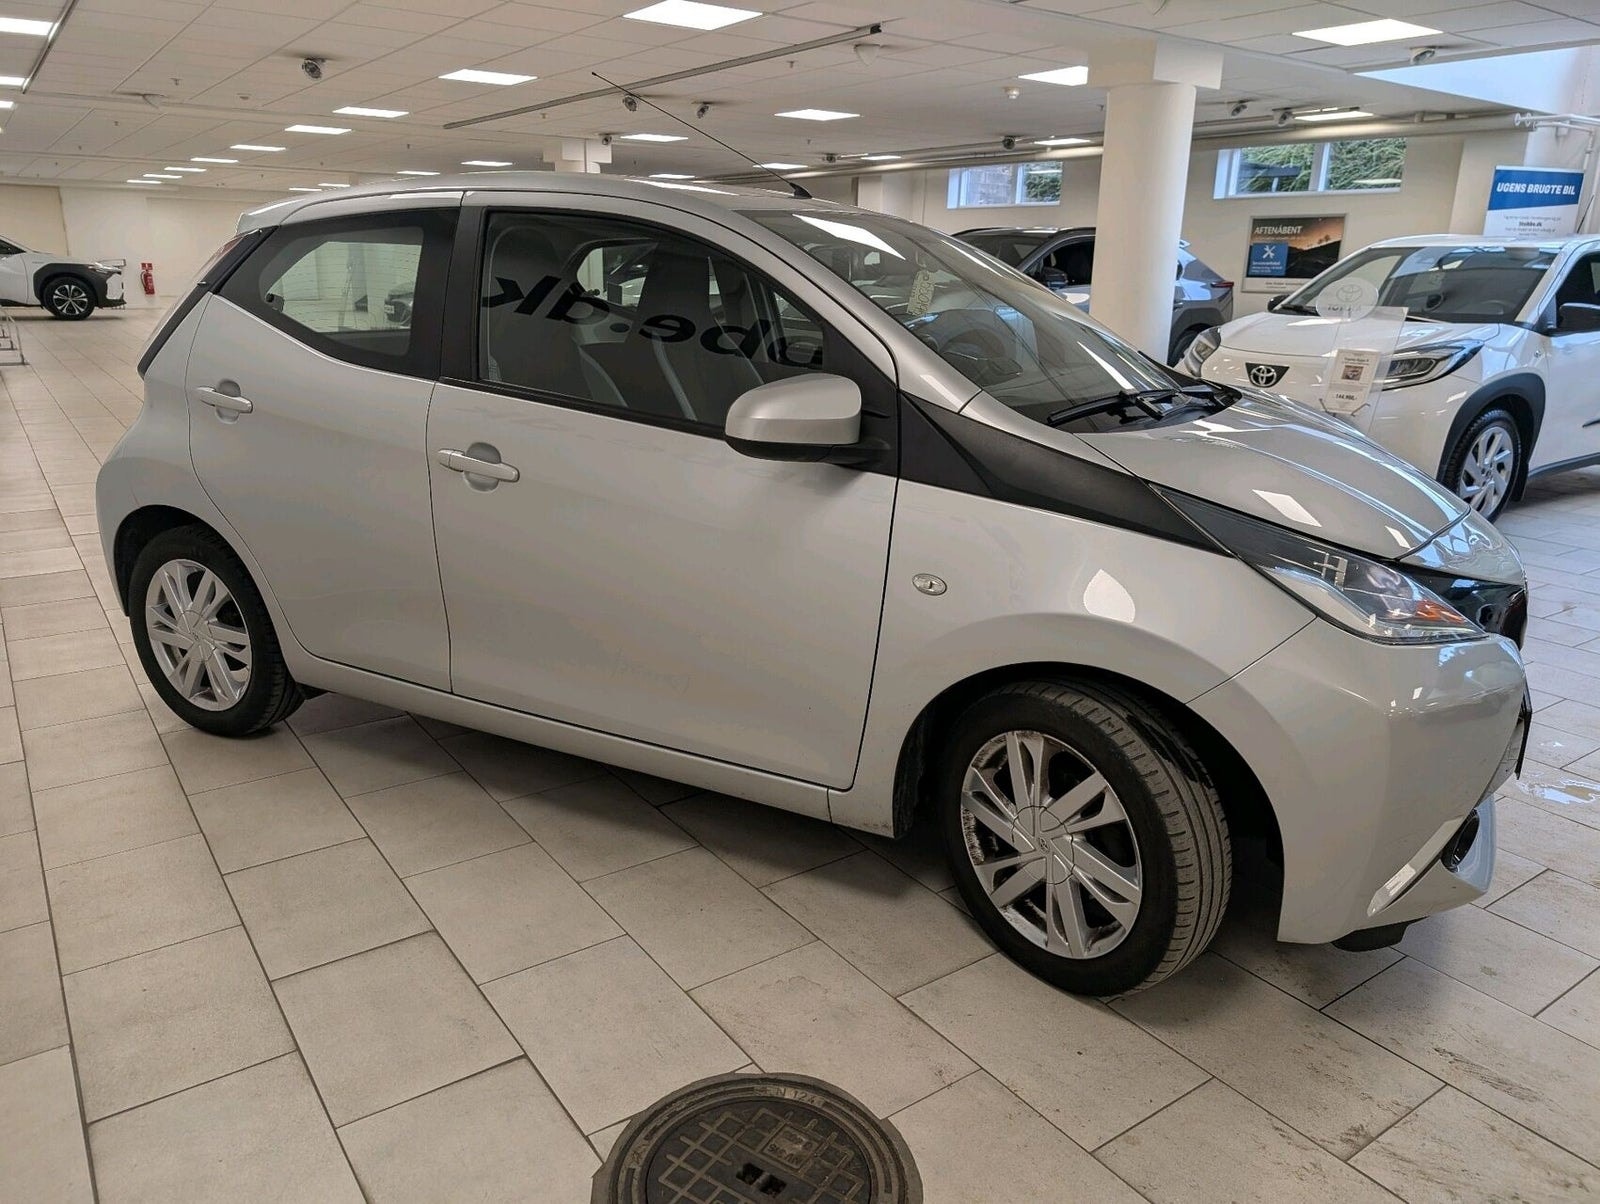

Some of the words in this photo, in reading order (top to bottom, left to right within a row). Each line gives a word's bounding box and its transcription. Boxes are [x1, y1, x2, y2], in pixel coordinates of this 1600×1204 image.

[1496, 182, 1526, 193] UGENS
[1527, 183, 1563, 195] BRUGTE
[1562, 185, 1576, 195] BIL
[1254, 224, 1303, 234] AFTENÅBENT
